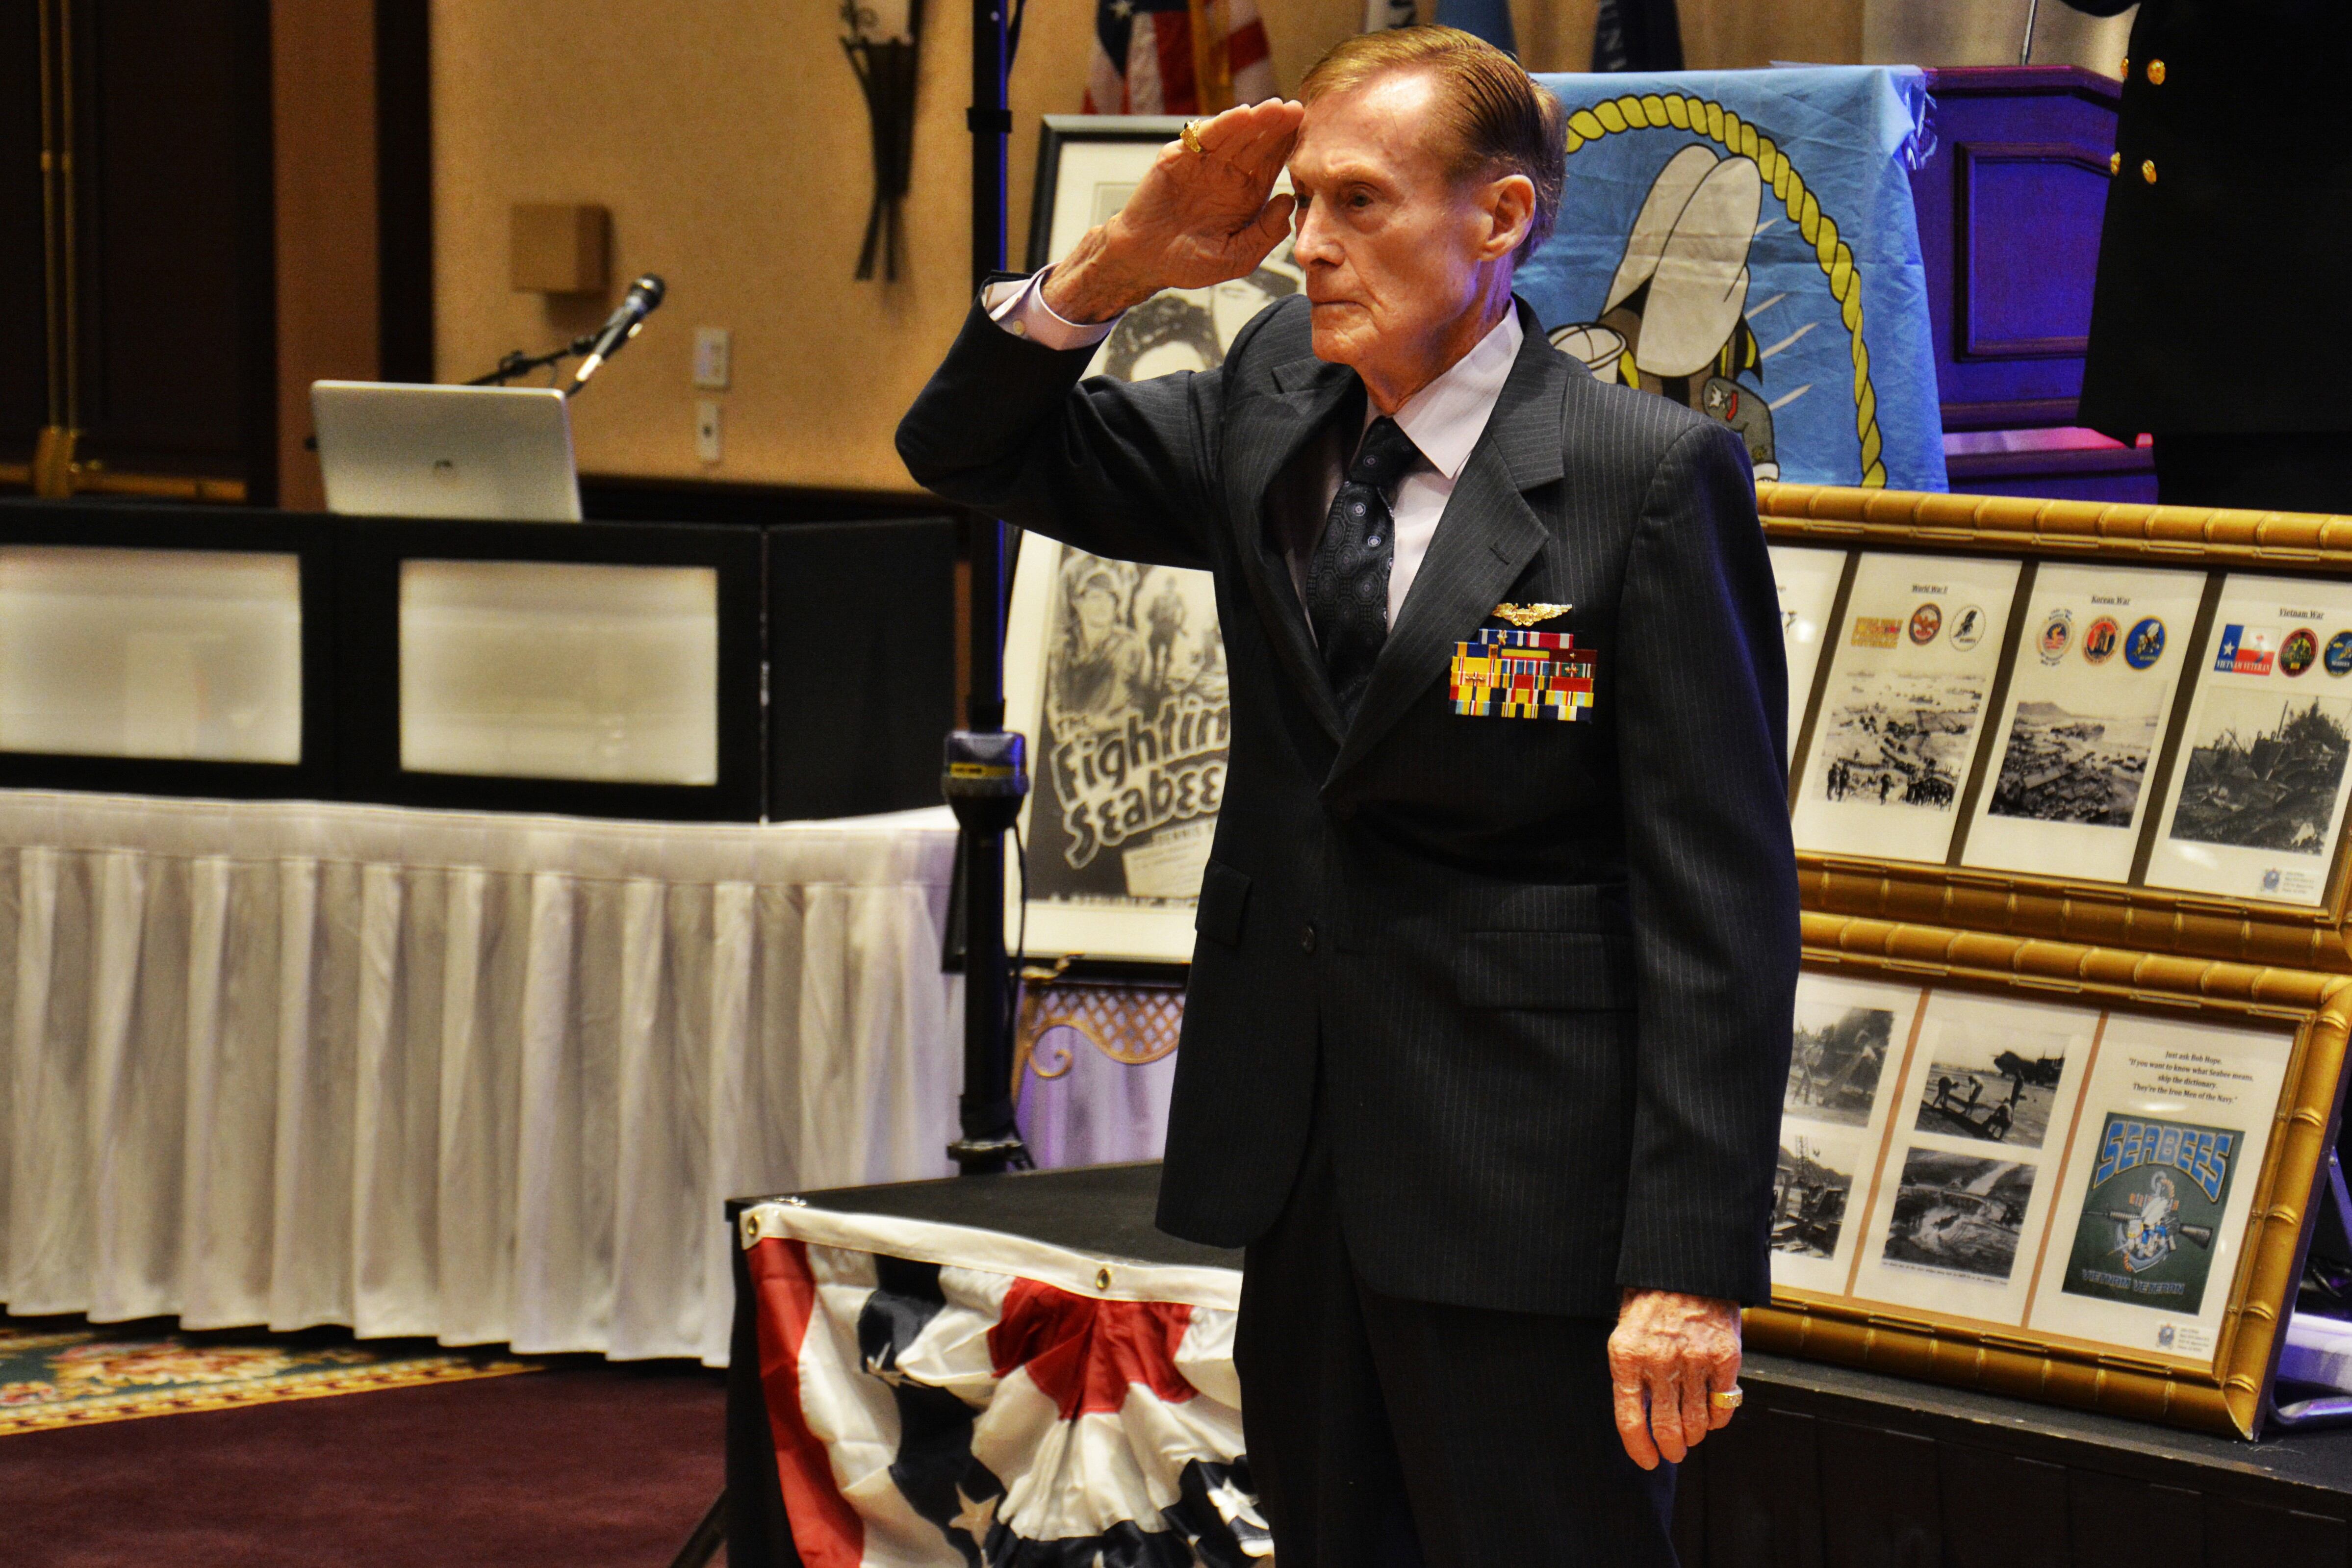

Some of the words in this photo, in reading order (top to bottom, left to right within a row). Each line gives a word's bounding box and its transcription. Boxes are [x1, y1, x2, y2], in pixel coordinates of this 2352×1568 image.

[2091, 595, 2115, 604] Korean
[2116, 596, 2131, 606] War
[2279, 608, 2308, 618] Vietnam
[2309, 610, 2325, 620] War
[1053, 697, 1231, 802] Fightin
[1067, 767, 1222, 867] Seabee
[2165, 1051, 2177, 1059] Just
[2191, 1054, 2203, 1062] Bob
[2205, 1055, 2222, 1066] Hope.
[2158, 1074, 2172, 1084] skip
[2173, 1064, 2191, 1073] know
[2192, 1067, 2208, 1076] what
[2209, 1069, 2231, 1079] Seabee
[2133, 1082, 2156, 1093] They're
[2157, 1086, 2168, 1095] the
[2169, 1088, 2182, 1097] Iron
[2183, 1090, 2197, 1099] Men
[2205, 1093, 2216, 1102] the
[2092, 1120, 2234, 1204] SEABEES
[2082, 1268, 2132, 1289] VIETNAM
[2133, 1279, 2186, 1295] VETERAN
